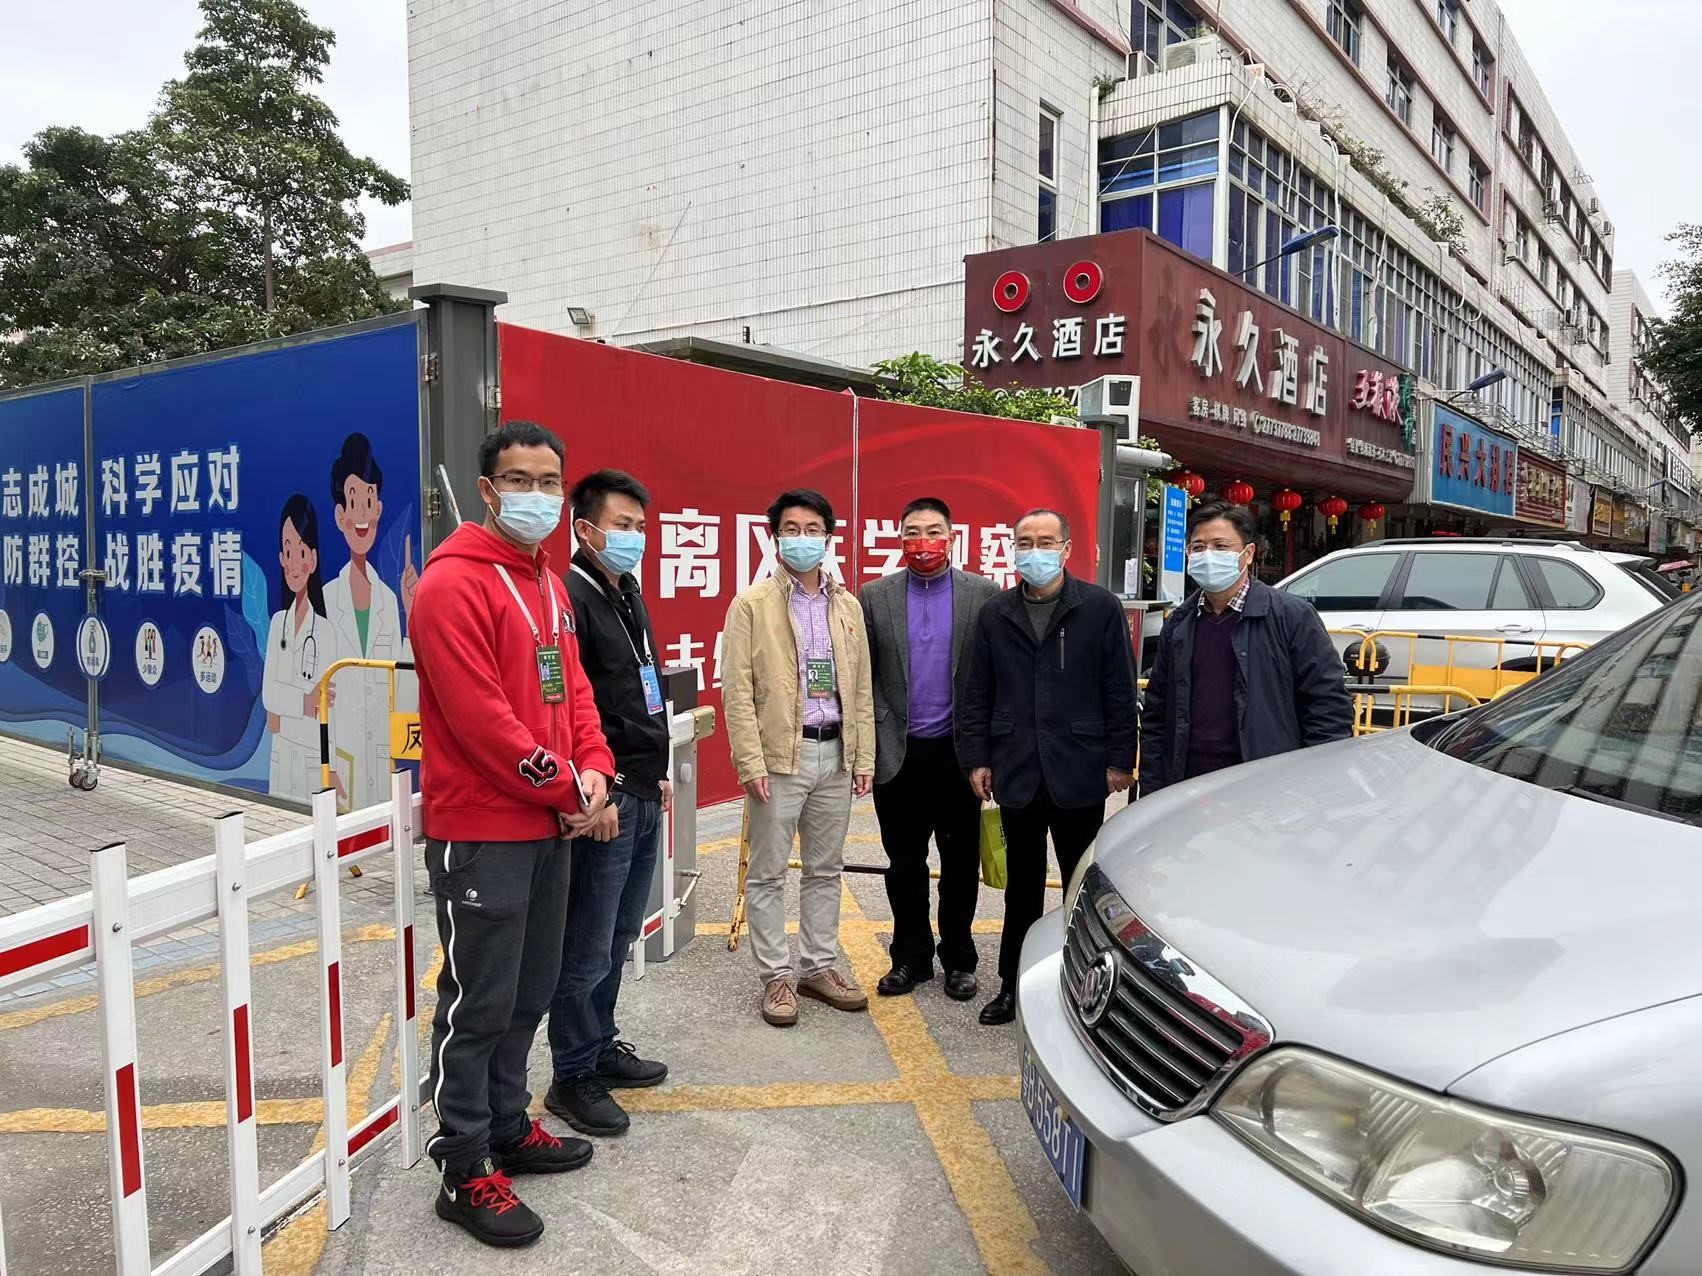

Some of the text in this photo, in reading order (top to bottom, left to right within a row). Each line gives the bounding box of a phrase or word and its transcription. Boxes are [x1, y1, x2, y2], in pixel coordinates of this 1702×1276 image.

[971, 312, 1128, 368] 永久酒店
[1191, 288, 1329, 416] 永久酒店
[1, 445, 240, 518] 志成城 科学应对
[2, 531, 242, 596] 防群控 战胜疫情
